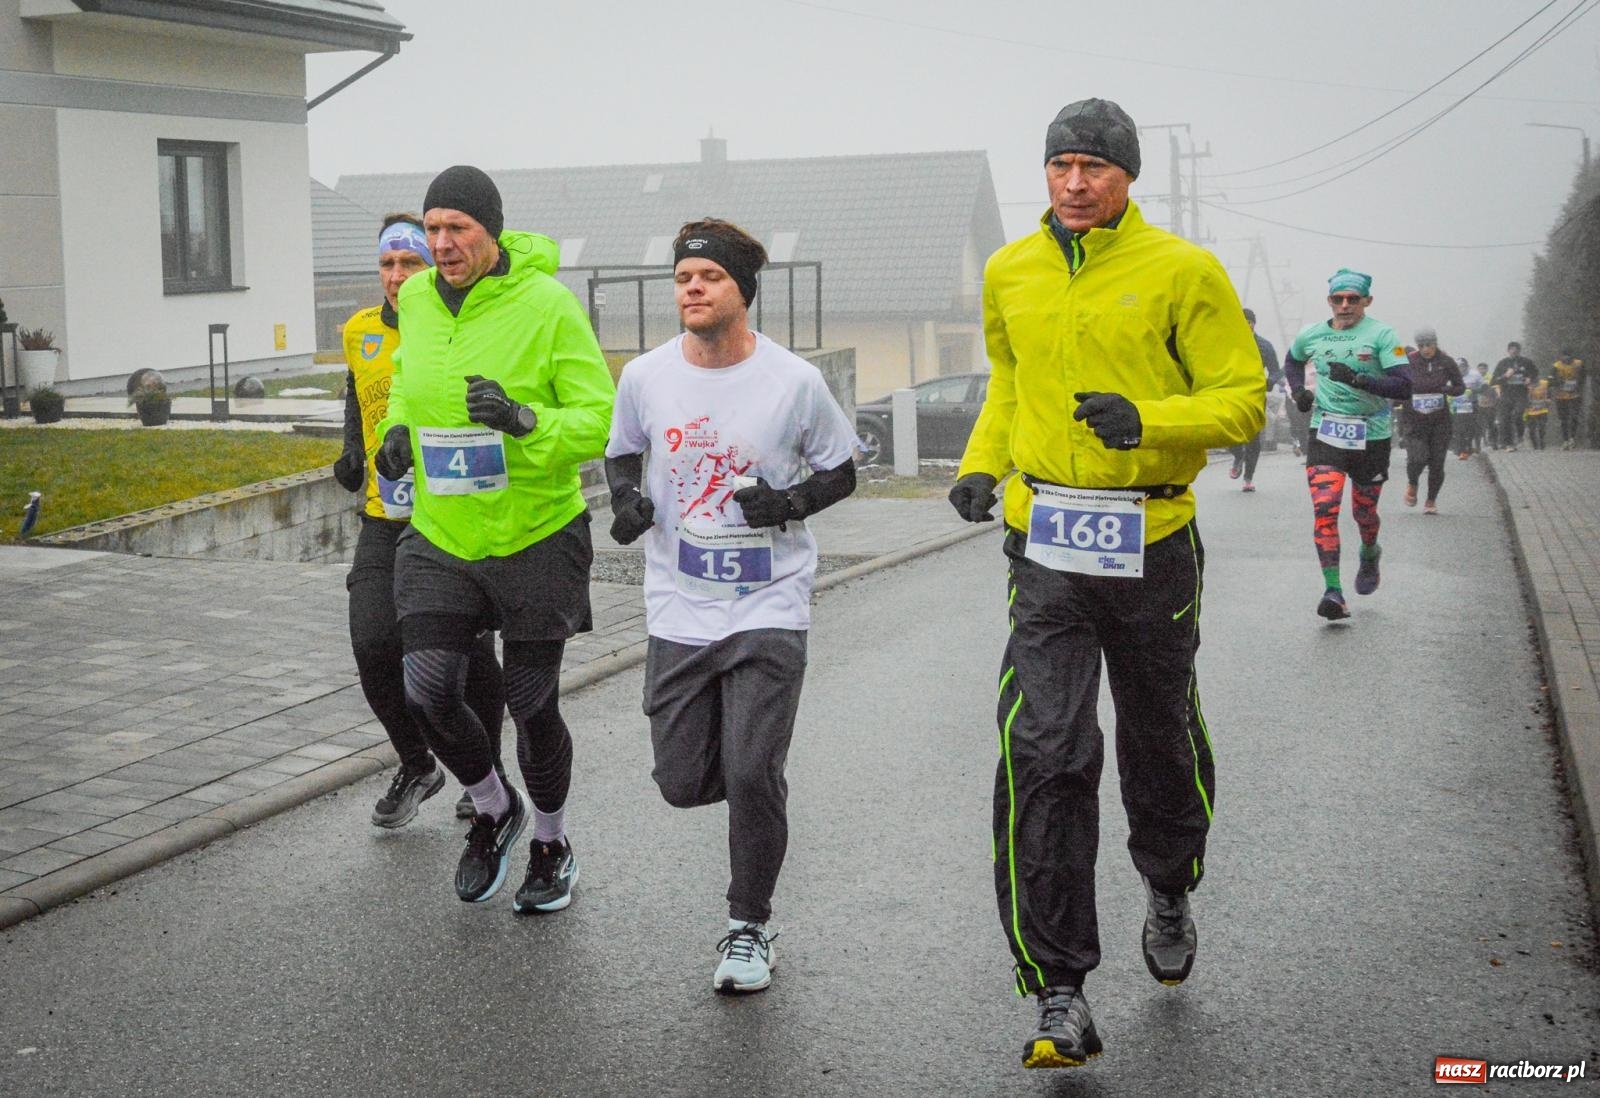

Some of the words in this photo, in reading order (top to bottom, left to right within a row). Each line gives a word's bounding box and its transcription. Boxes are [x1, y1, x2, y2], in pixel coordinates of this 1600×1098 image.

[664, 427, 683, 452] 9
[1328, 422, 1357, 439] 198
[448, 449, 468, 476] 4
[1049, 511, 1122, 550] 168
[700, 551, 742, 580] 15
